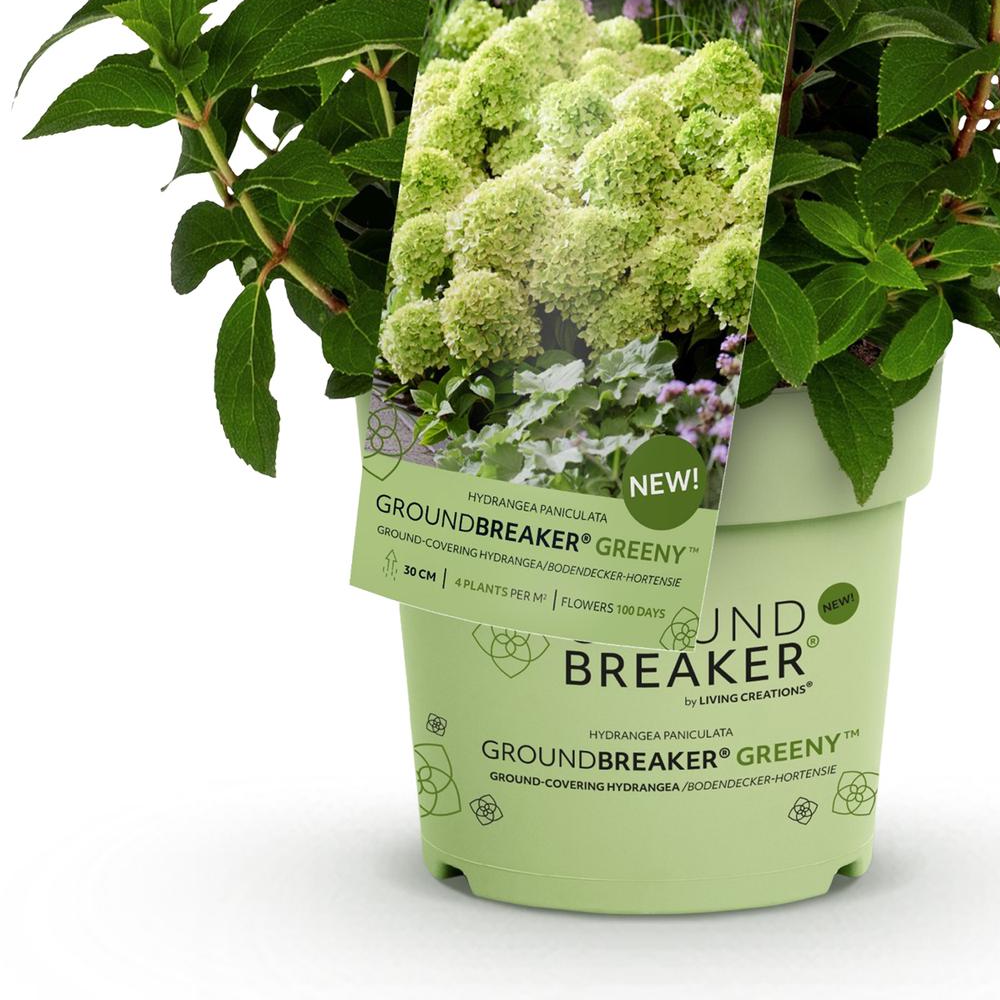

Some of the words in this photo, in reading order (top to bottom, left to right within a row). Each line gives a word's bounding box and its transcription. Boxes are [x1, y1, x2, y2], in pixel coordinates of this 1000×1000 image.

[628, 468, 700, 499] NEW!
[468, 491, 537, 513] HYDRANGEA
[540, 504, 608, 523] PANICULATA
[377, 525, 477, 558] GROUND-COVERING
[403, 565, 416, 577] 30
[418, 569, 436, 582] CM
[455, 578, 462, 588] 4
[464, 579, 508, 598] PLANTS
[510, 588, 531, 602] PER
[561, 597, 614, 614] FLOWERS
[617, 604, 634, 616] 100
[637, 607, 665, 619] DAYS
[822, 593, 854, 613] NEW!
[685, 697, 697, 708] by
[700, 693, 738, 705] LIVING
[589, 730, 661, 741] HYDRANGEA
[664, 728, 734, 740] PANICULATA
[490, 771, 605, 791] GROUND-COVERING
[607, 783, 680, 793] HYDRANGEA
